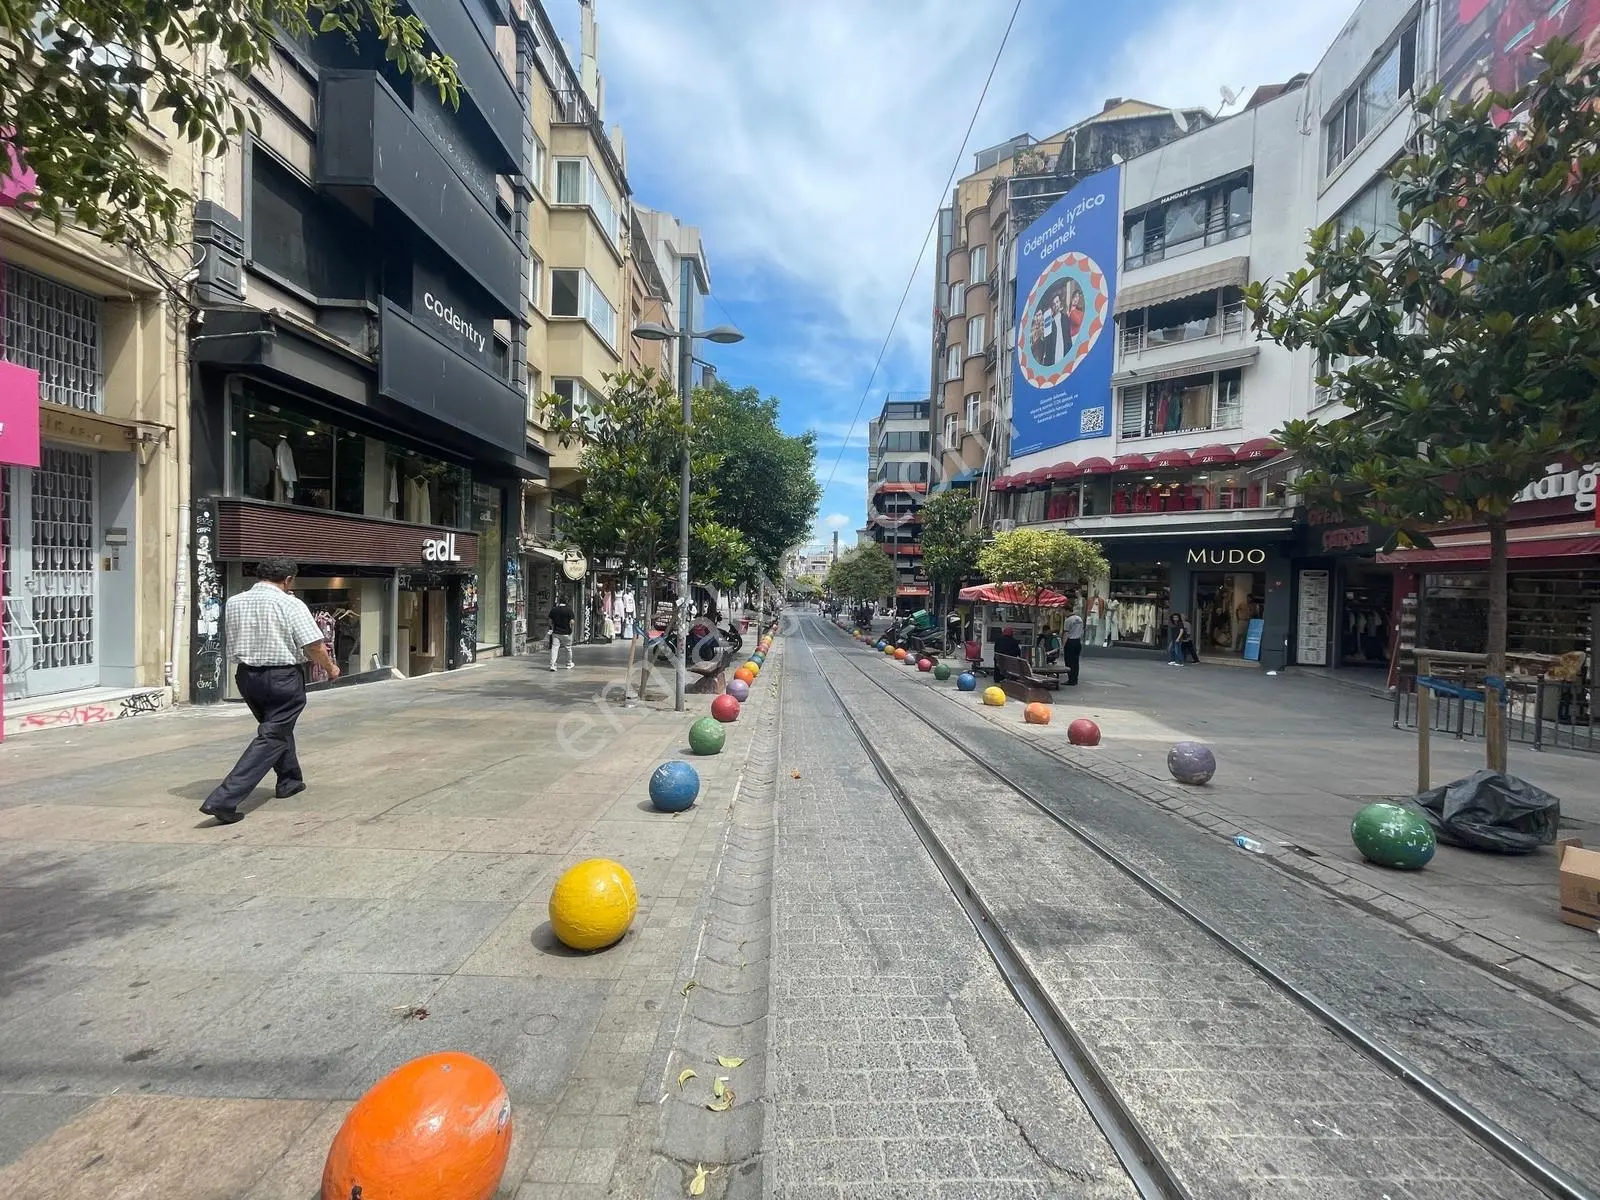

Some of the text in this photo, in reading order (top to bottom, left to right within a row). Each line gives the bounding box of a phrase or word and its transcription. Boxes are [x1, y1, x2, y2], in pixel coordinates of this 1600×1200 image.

[1023, 193, 1106, 256] Ödemek iyzico
[1040, 225, 1076, 260] demek
[423, 290, 487, 353] codentry
[1187, 548, 1266, 564] MUDO
